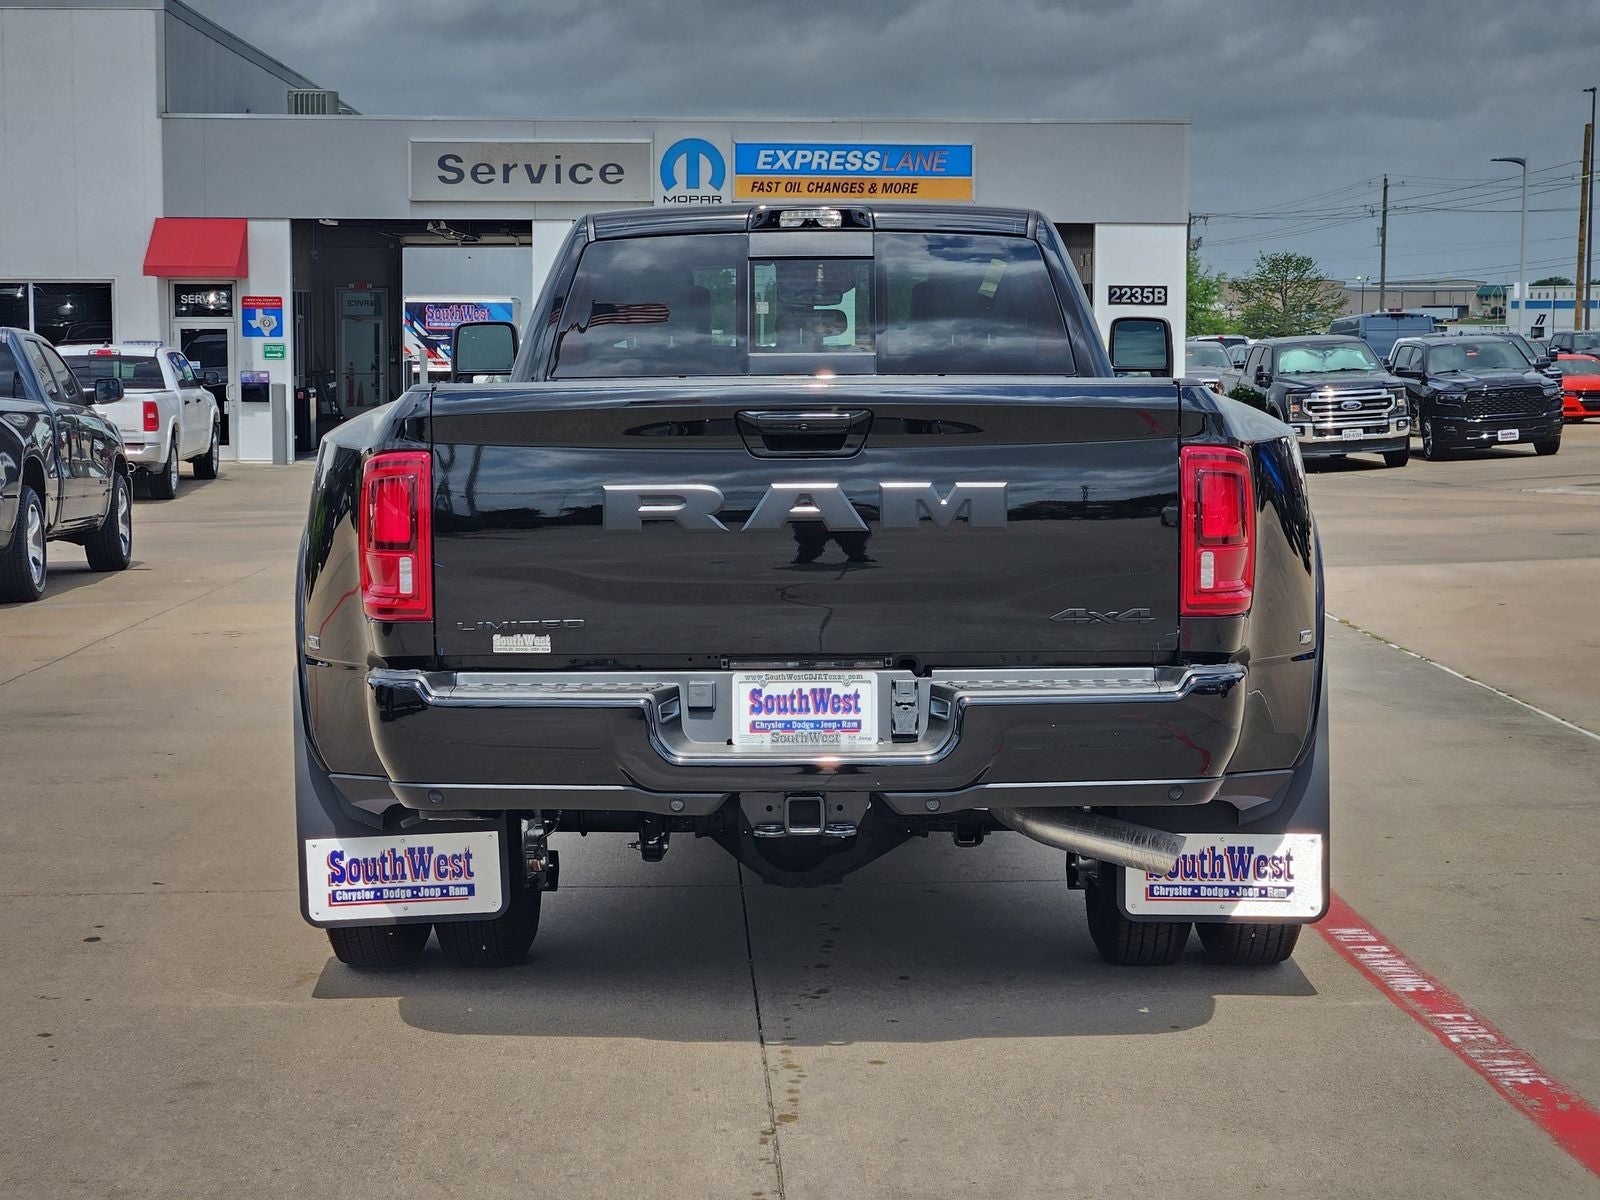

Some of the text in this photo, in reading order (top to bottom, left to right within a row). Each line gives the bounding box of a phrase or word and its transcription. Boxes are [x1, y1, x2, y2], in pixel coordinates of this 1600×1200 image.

[437, 153, 625, 185] Service
[750, 180, 919, 194] FAST OIL CHANGES & MORE
[663, 195, 723, 204] MOPAR
[1110, 287, 1166, 303] 2235B
[426, 304, 491, 321] SouthWest
[601, 481, 1008, 533] RAM
[456, 618, 585, 631] LIMITED
[493, 633, 551, 647] SouthWest
[749, 687, 861, 716] SouthWest
[755, 721, 859, 731] Chrysler Dodge Jeep Ram
[770, 731, 842, 744] SouthWest
[327, 844, 476, 887] SouthWest
[1145, 845, 1296, 882] outhWest
[335, 885, 469, 902] Chrysler Dodge Jeep Ram
[1153, 886, 1288, 898] Chrysler Dodge Jeep Ram
[1327, 927, 1378, 942] NO
